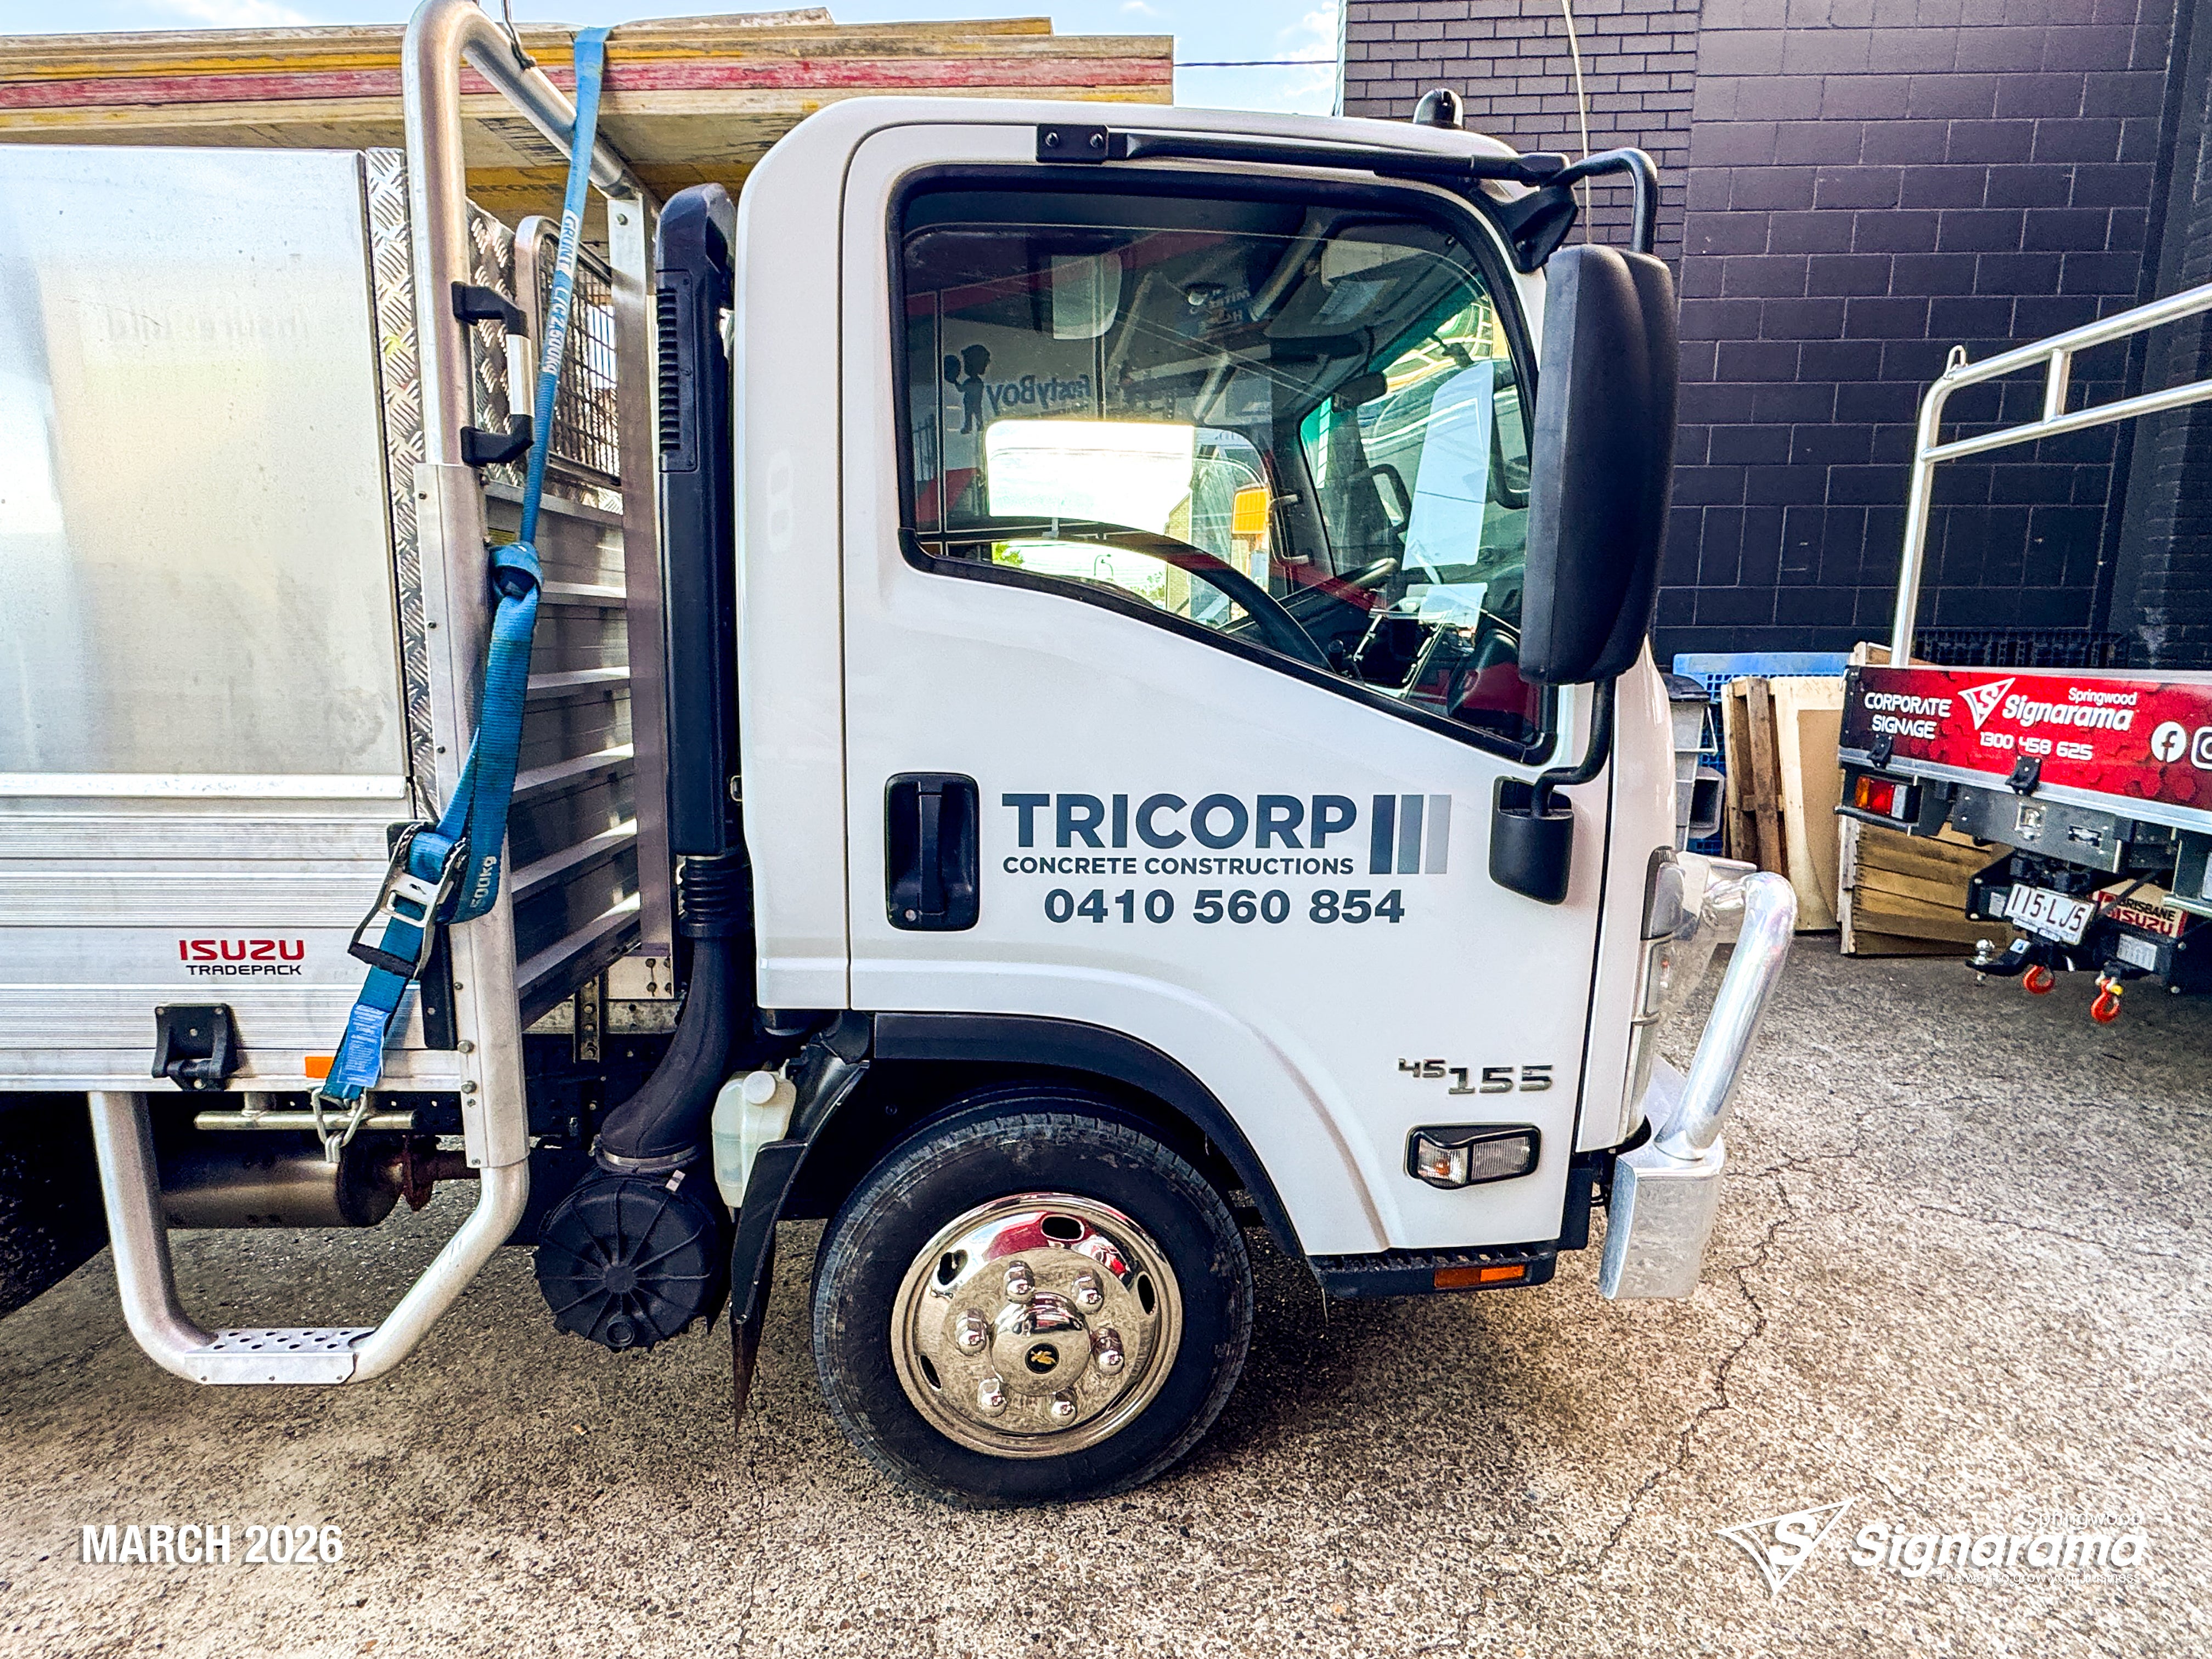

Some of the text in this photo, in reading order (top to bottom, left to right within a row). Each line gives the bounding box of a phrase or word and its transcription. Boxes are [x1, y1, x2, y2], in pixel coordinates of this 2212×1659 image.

[1864, 692, 1952, 718] CORPORATE
[2068, 687, 2138, 706] Springwood
[2002, 694, 2134, 731] Signarama
[1872, 714, 1937, 740] SIGNAGE
[1979, 731, 2093, 760] 1300 458 625
[1001, 793, 1357, 849] TRICORP
[1002, 856, 1354, 875] CONCRETE CONSTRUCTIONS
[1044, 888, 1405, 924] 0410 560 854
[178, 940, 305, 961] ISUZU
[185, 964, 302, 975] TRADEPACK
[1448, 1064, 1554, 1095] 155
